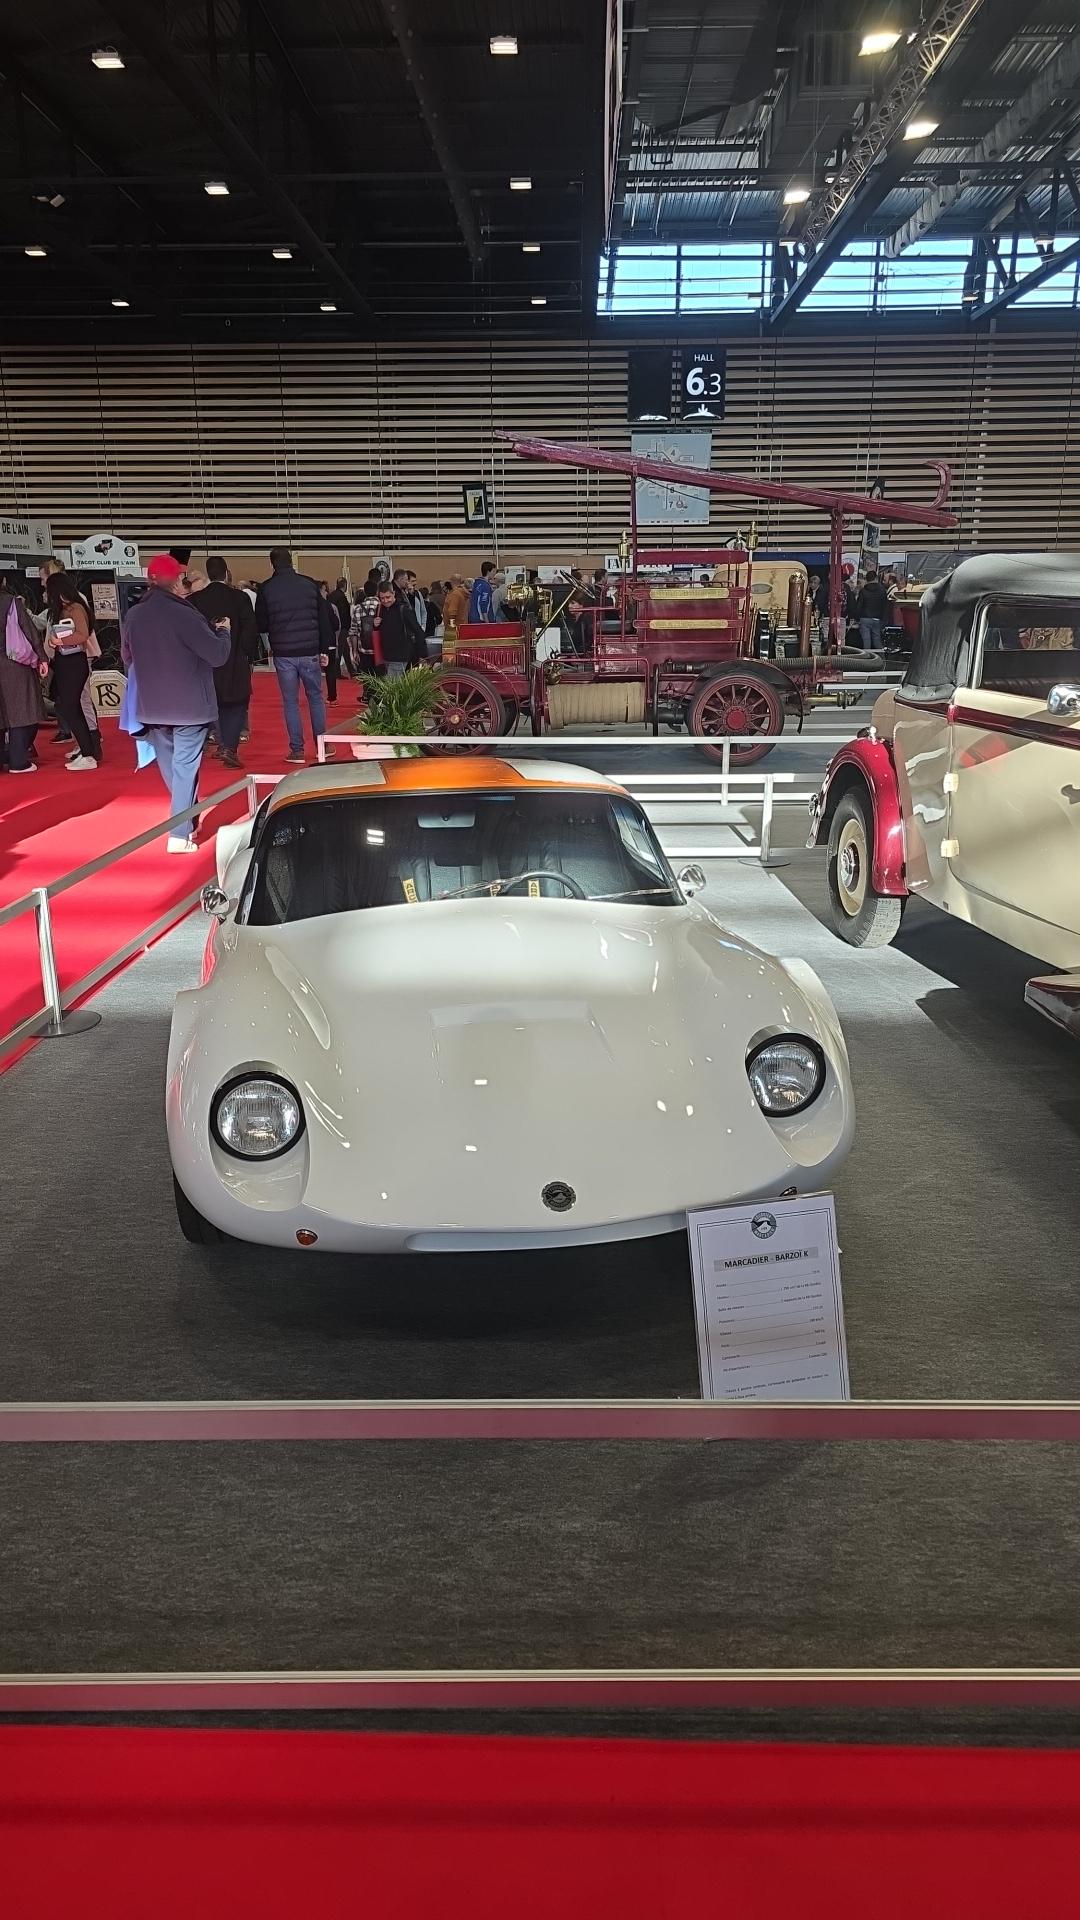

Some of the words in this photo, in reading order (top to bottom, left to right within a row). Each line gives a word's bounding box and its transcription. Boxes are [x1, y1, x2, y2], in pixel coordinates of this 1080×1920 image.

[694, 354, 714, 362] HALL
[686, 367, 721, 395] 6.3
[2, 522, 11, 534] DE
[12, 523, 29, 536] L'AIN
[724, 1255, 769, 1268] MARCADIER
